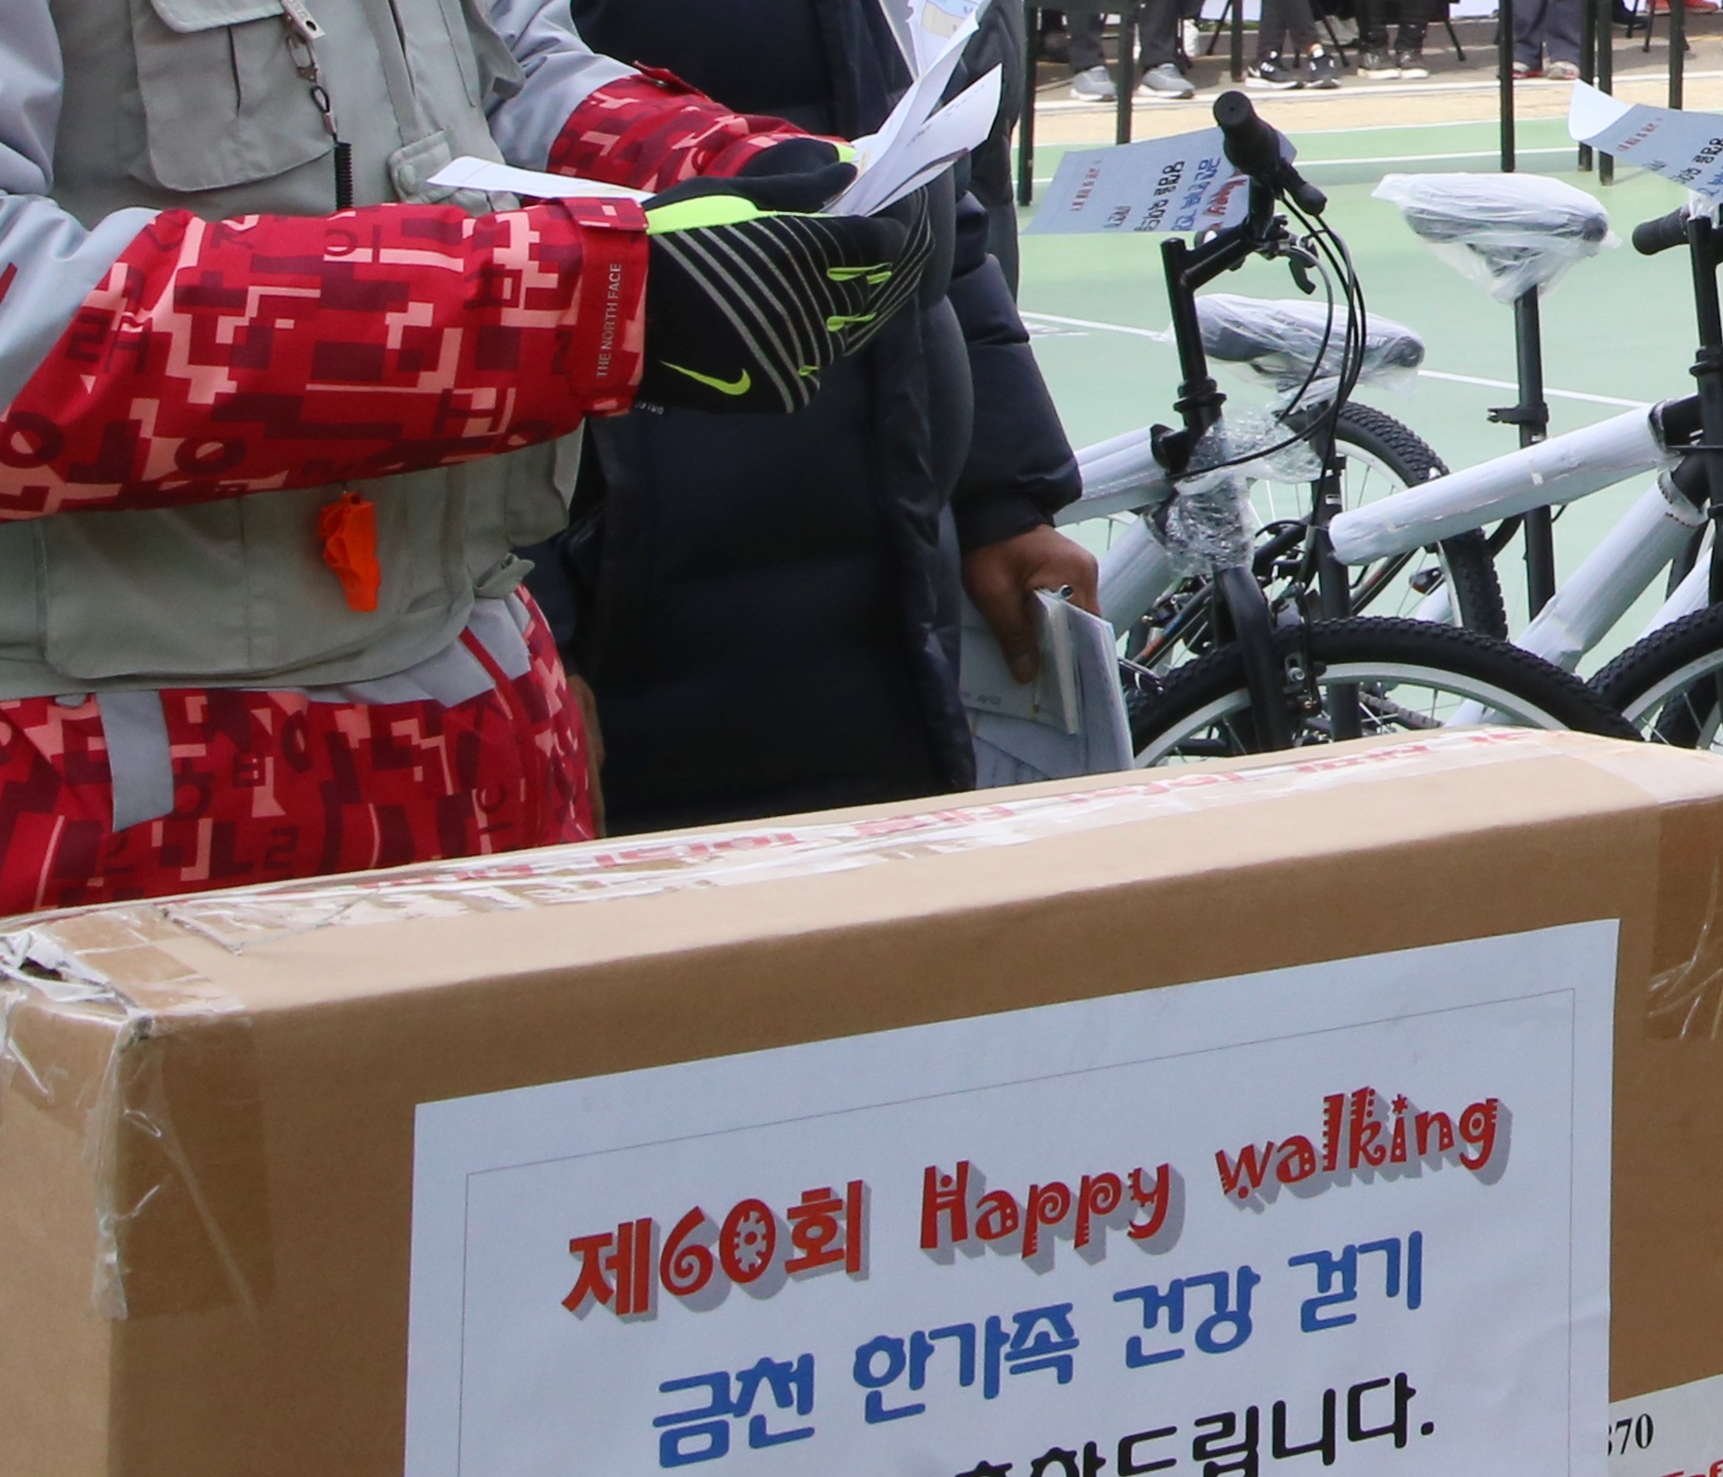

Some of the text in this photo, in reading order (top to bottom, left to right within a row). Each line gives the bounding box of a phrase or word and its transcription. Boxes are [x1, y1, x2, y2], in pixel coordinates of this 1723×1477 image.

[595, 263, 622, 379] THE NORTH FACE
[561, 1085, 1501, 1318] 제60회 Happy walking
[652, 1230, 1424, 1470] 금천 한가족 건강 걷기
[1608, 1413, 1654, 1456] 70
